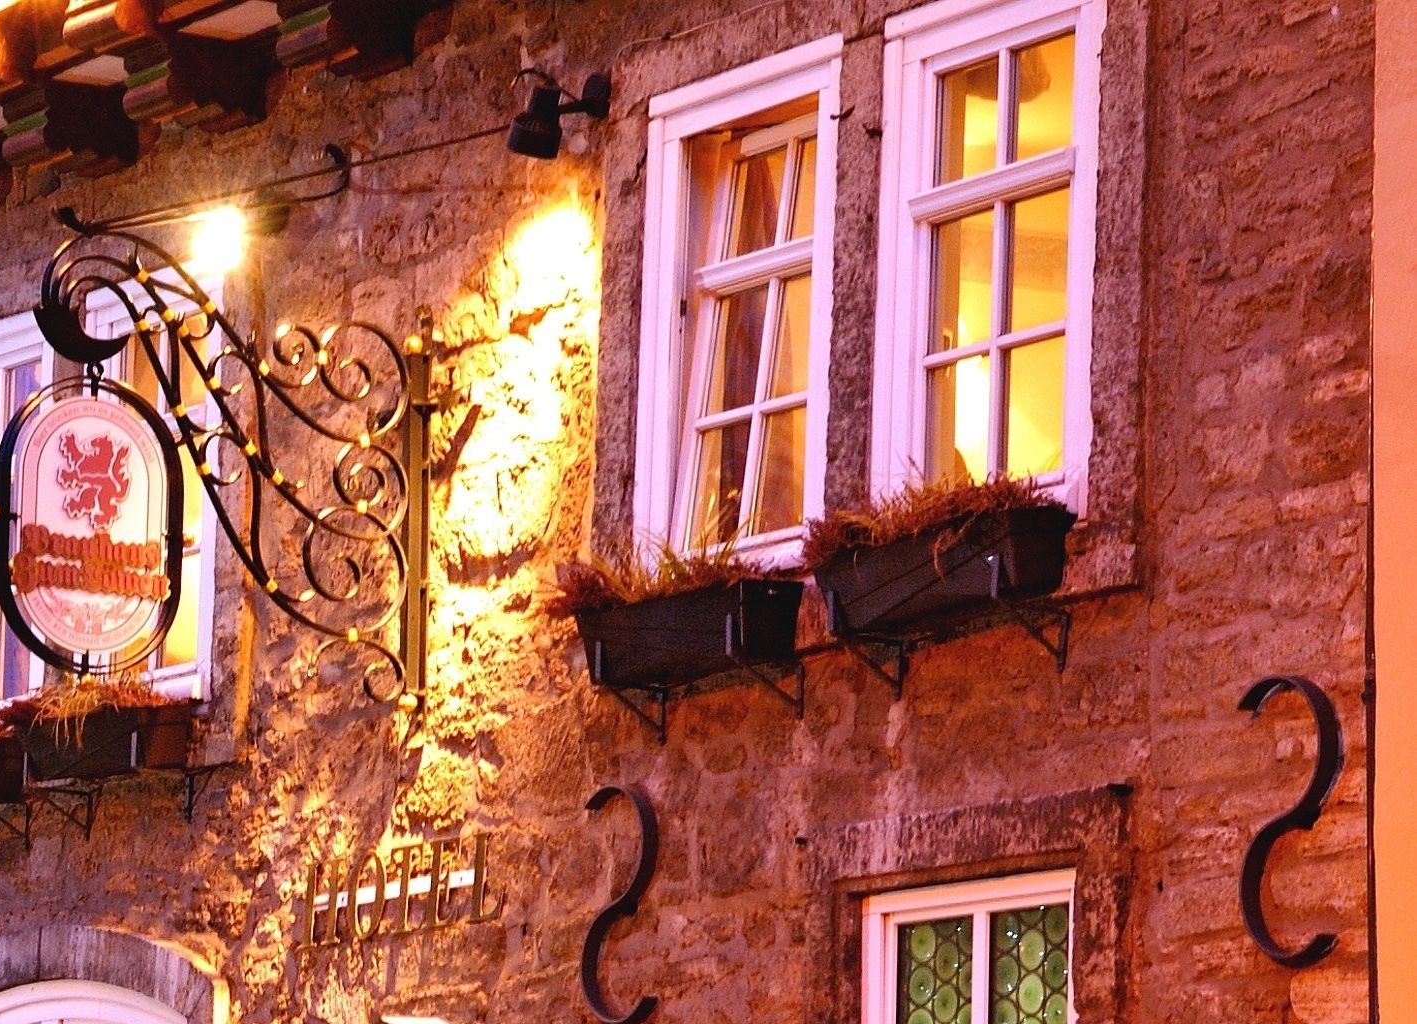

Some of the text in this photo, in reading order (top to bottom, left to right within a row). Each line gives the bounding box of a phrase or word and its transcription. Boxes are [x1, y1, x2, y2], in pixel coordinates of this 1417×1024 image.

[22, 524, 161, 570] Brauhaus
[13, 552, 80, 593] Zum
[295, 833, 506, 952] HOTEL
